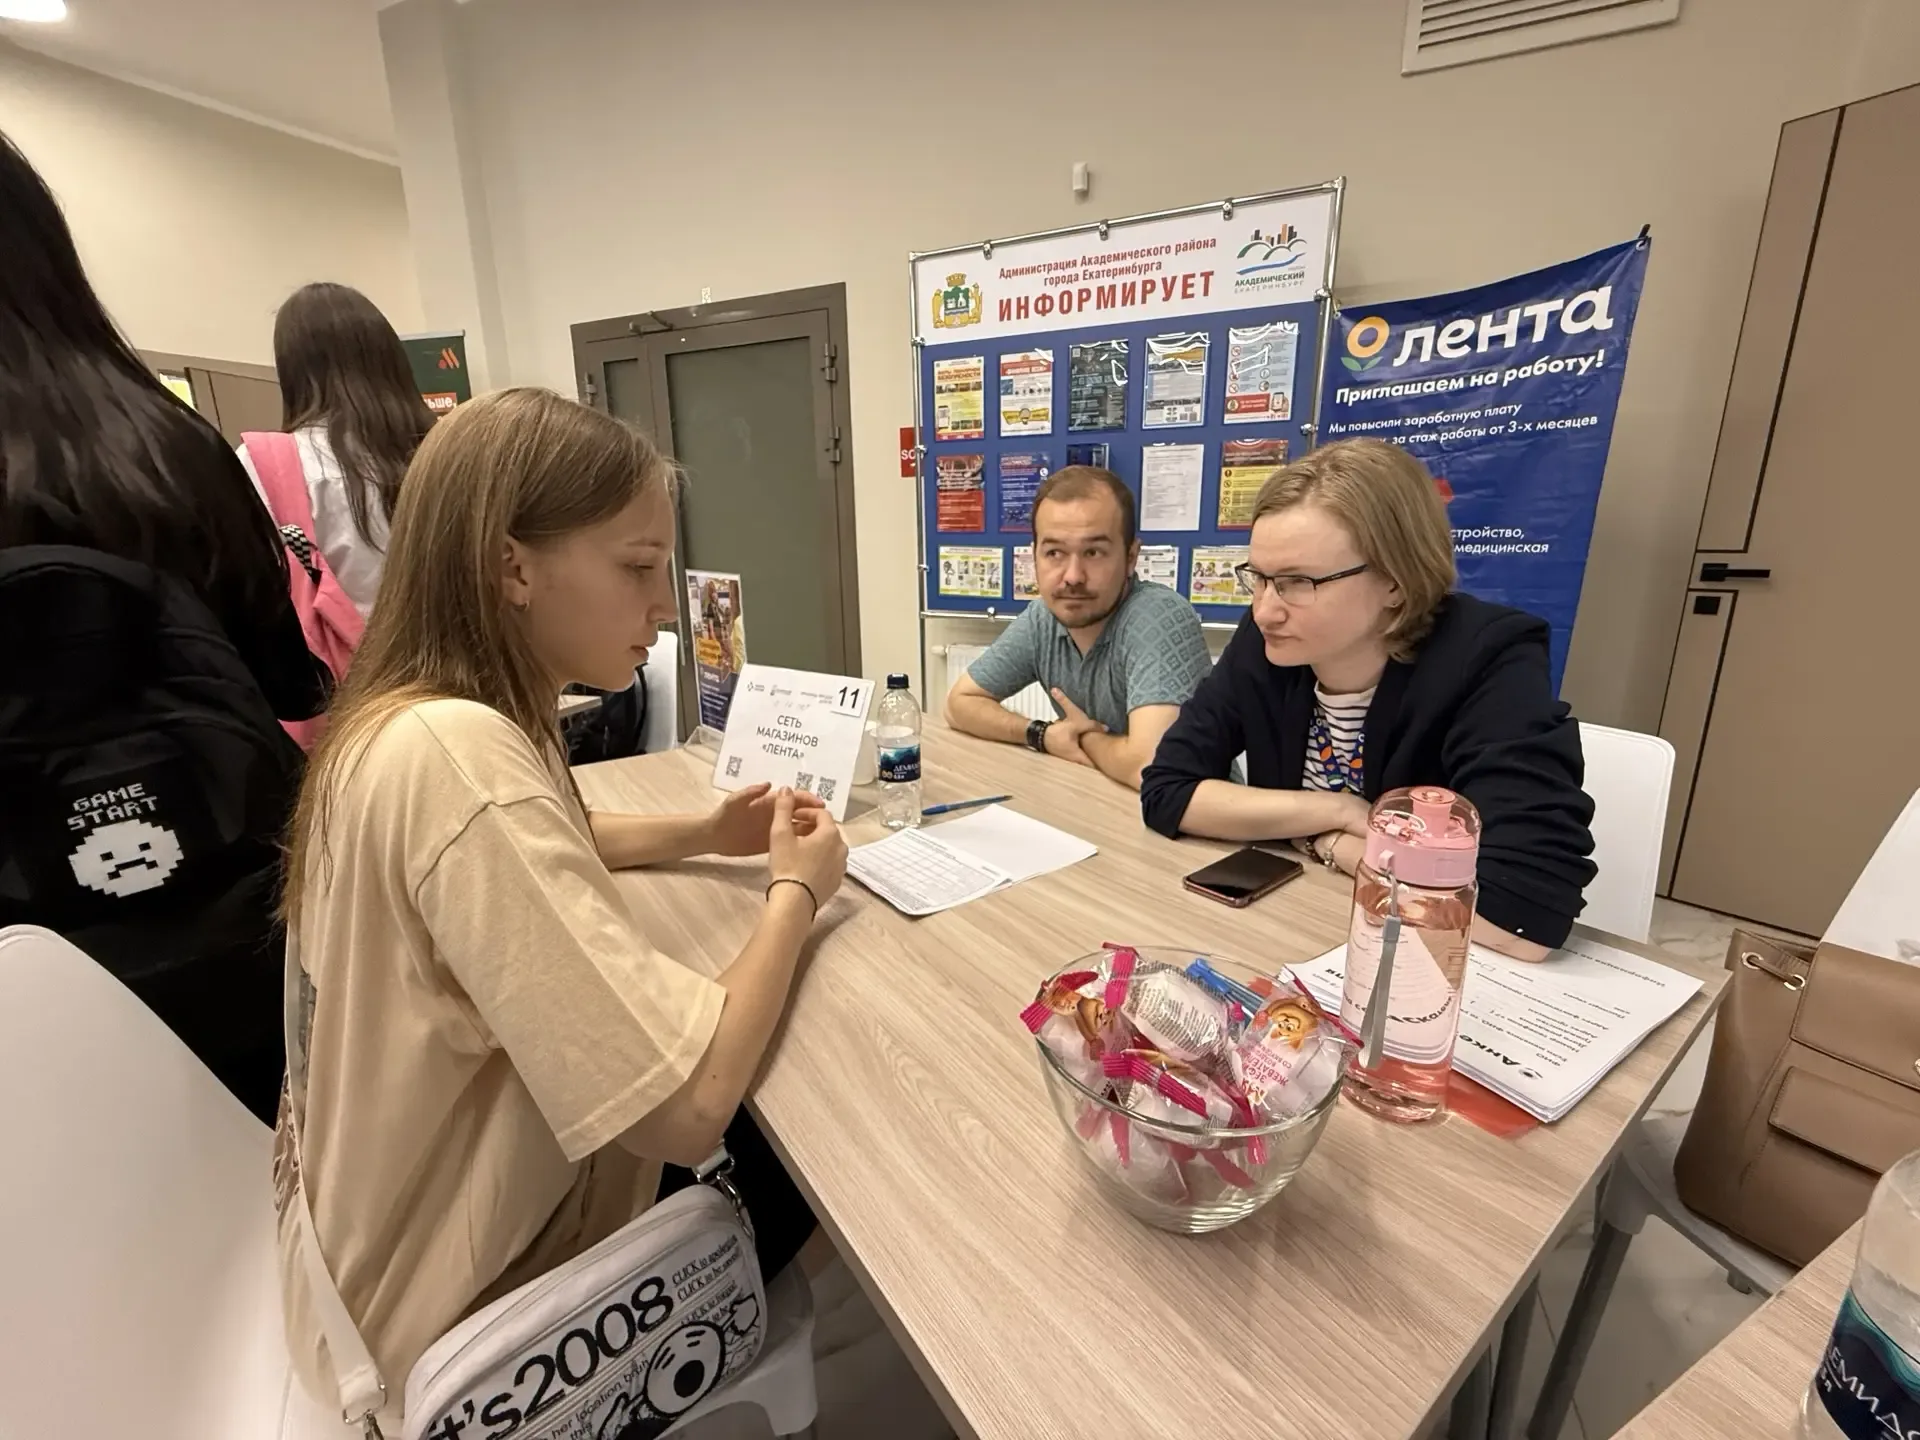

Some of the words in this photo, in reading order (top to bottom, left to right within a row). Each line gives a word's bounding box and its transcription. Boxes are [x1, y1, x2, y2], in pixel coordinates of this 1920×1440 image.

[999, 259, 1077, 279] Администрация
[1080, 244, 1171, 267] Академического
[1175, 237, 1217, 255] района
[1044, 272, 1079, 287] города
[1082, 261, 1162, 281] Екатеринбурга
[1235, 270, 1305, 287] АКАДЕМИЧЕСКИЙ
[998, 270, 1215, 322] ИНФОРМИРУЕТ
[1234, 280, 1305, 294] ЕКАТЕРИНБУРГ
[1335, 377, 1464, 407] Приглашаем
[1470, 371, 1498, 387] на
[1503, 349, 1605, 387] работу!
[424, 396, 457, 409] ьше,
[1329, 423, 1347, 434] Мы
[1348, 418, 1401, 431] повысили
[1404, 409, 1481, 428] заработную
[1485, 404, 1522, 417] плату
[1392, 435, 1406, 445] за
[1408, 433, 1438, 443] стаж
[1440, 426, 1486, 443] работы
[1489, 425, 1505, 434] от
[1507, 421, 1532, 433] 3-х
[1536, 416, 1598, 431] месяцев
[1450, 526, 1525, 541] стройство,
[1453, 543, 1549, 554] медицинская
[839, 686, 860, 709] 11
[777, 715, 802, 728] СЕТЬ
[756, 726, 819, 747] МАГАЗИНОВ
[762, 743, 804, 760] «ЛЕНТА»
[72, 782, 146, 812] GAME
[66, 796, 158, 831] START
[1459, 1032, 1521, 1066] Анке
[1246, 1053, 1289, 1087] ЖЕВАТЕЛЬ
[672, 1260, 700, 1285] CLICK
[677, 1276, 705, 1301] CLICK
[551, 1419, 573, 1439] her
[575, 1381, 623, 1421] location
